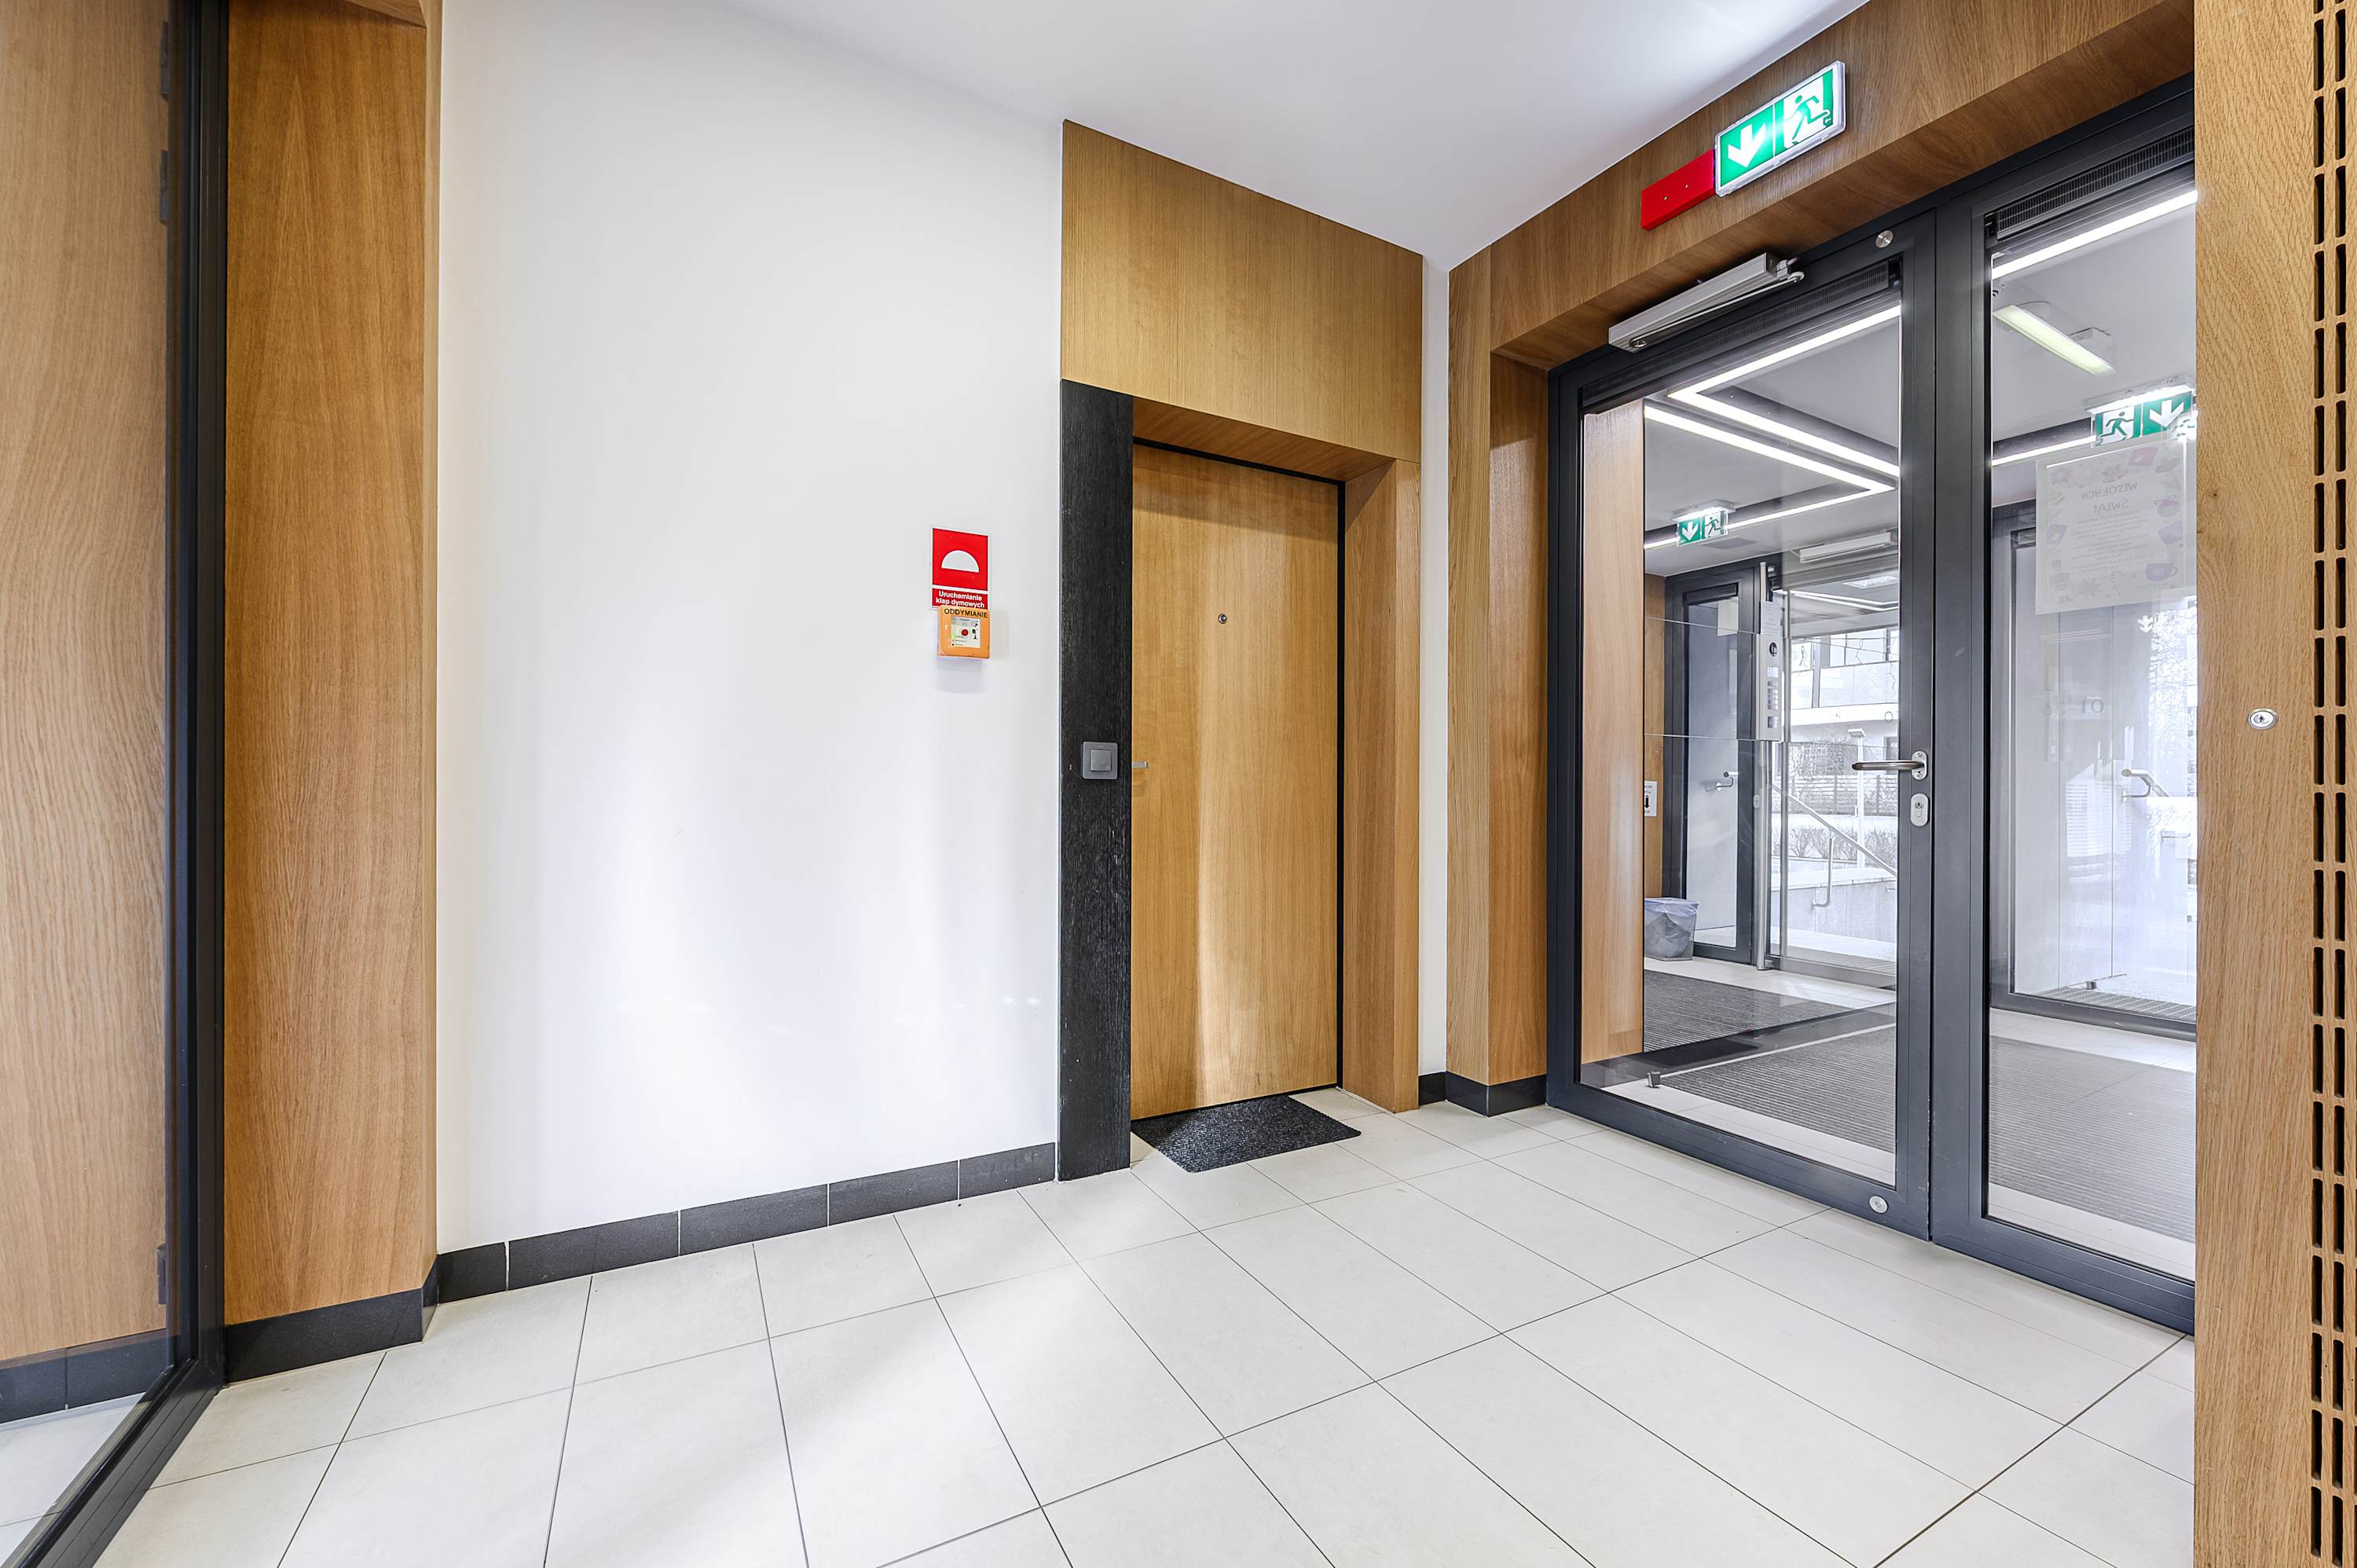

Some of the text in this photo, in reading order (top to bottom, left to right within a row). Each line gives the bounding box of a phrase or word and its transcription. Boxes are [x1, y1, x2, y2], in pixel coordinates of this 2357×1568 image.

[938, 591, 982, 601] Uruchamianie
[951, 599, 985, 608] dymowych
[944, 608, 988, 618] ODDYMIANIE
